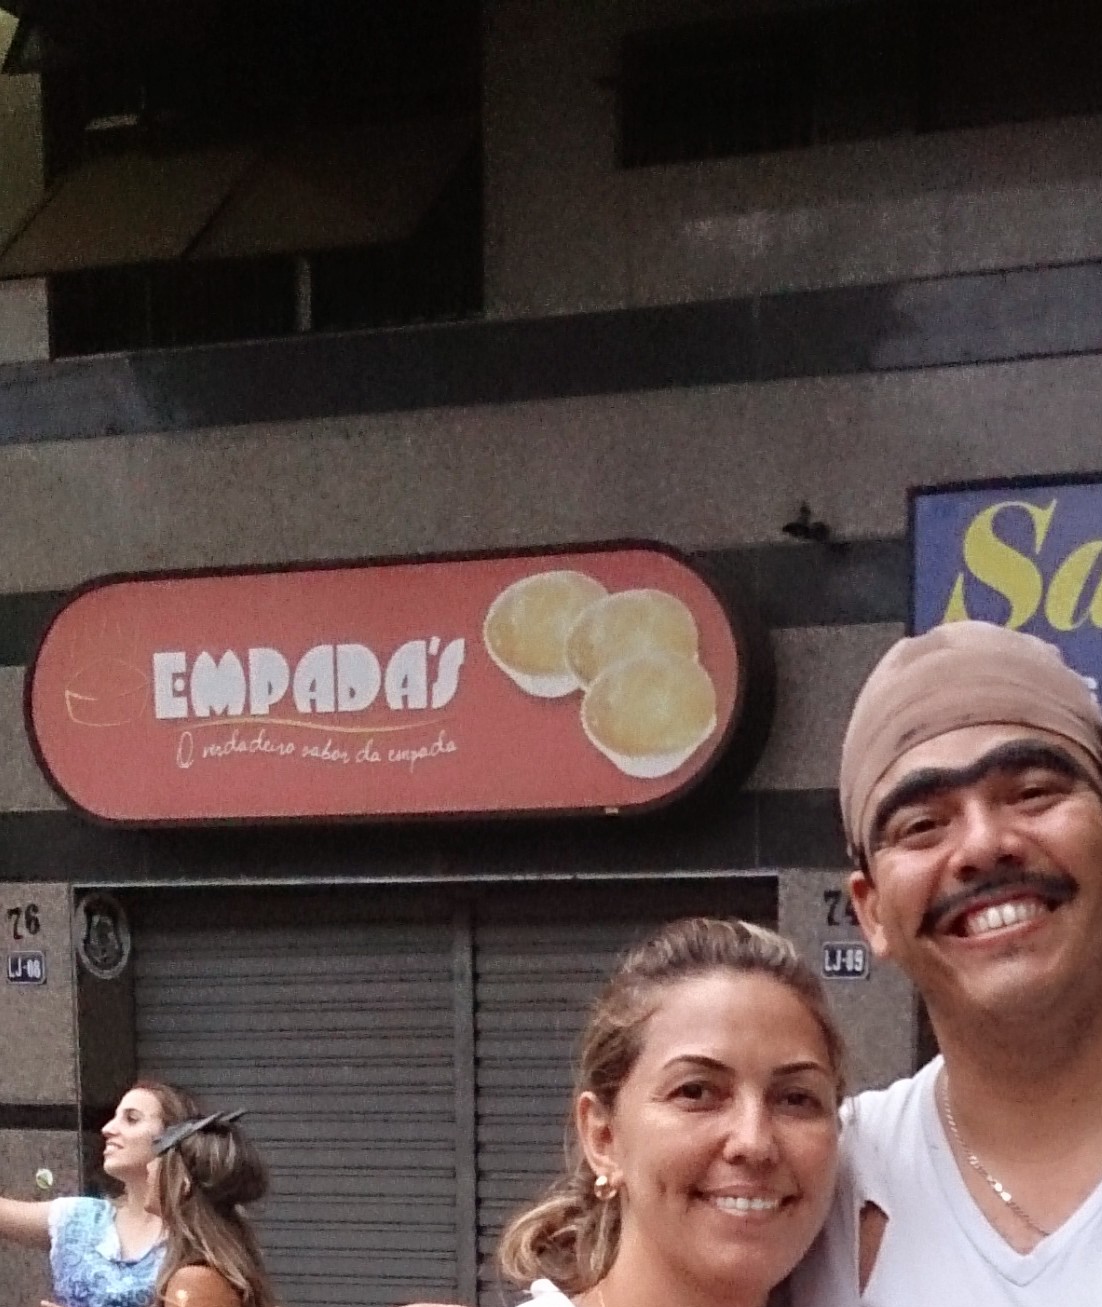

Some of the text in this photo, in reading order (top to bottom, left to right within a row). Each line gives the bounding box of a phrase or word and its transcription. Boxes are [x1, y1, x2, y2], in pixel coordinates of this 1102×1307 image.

[152, 636, 466, 720] EMPADA'S
[176, 729, 458, 773] O verdadeiro sabor da empada
[7, 903, 40, 940] 76
